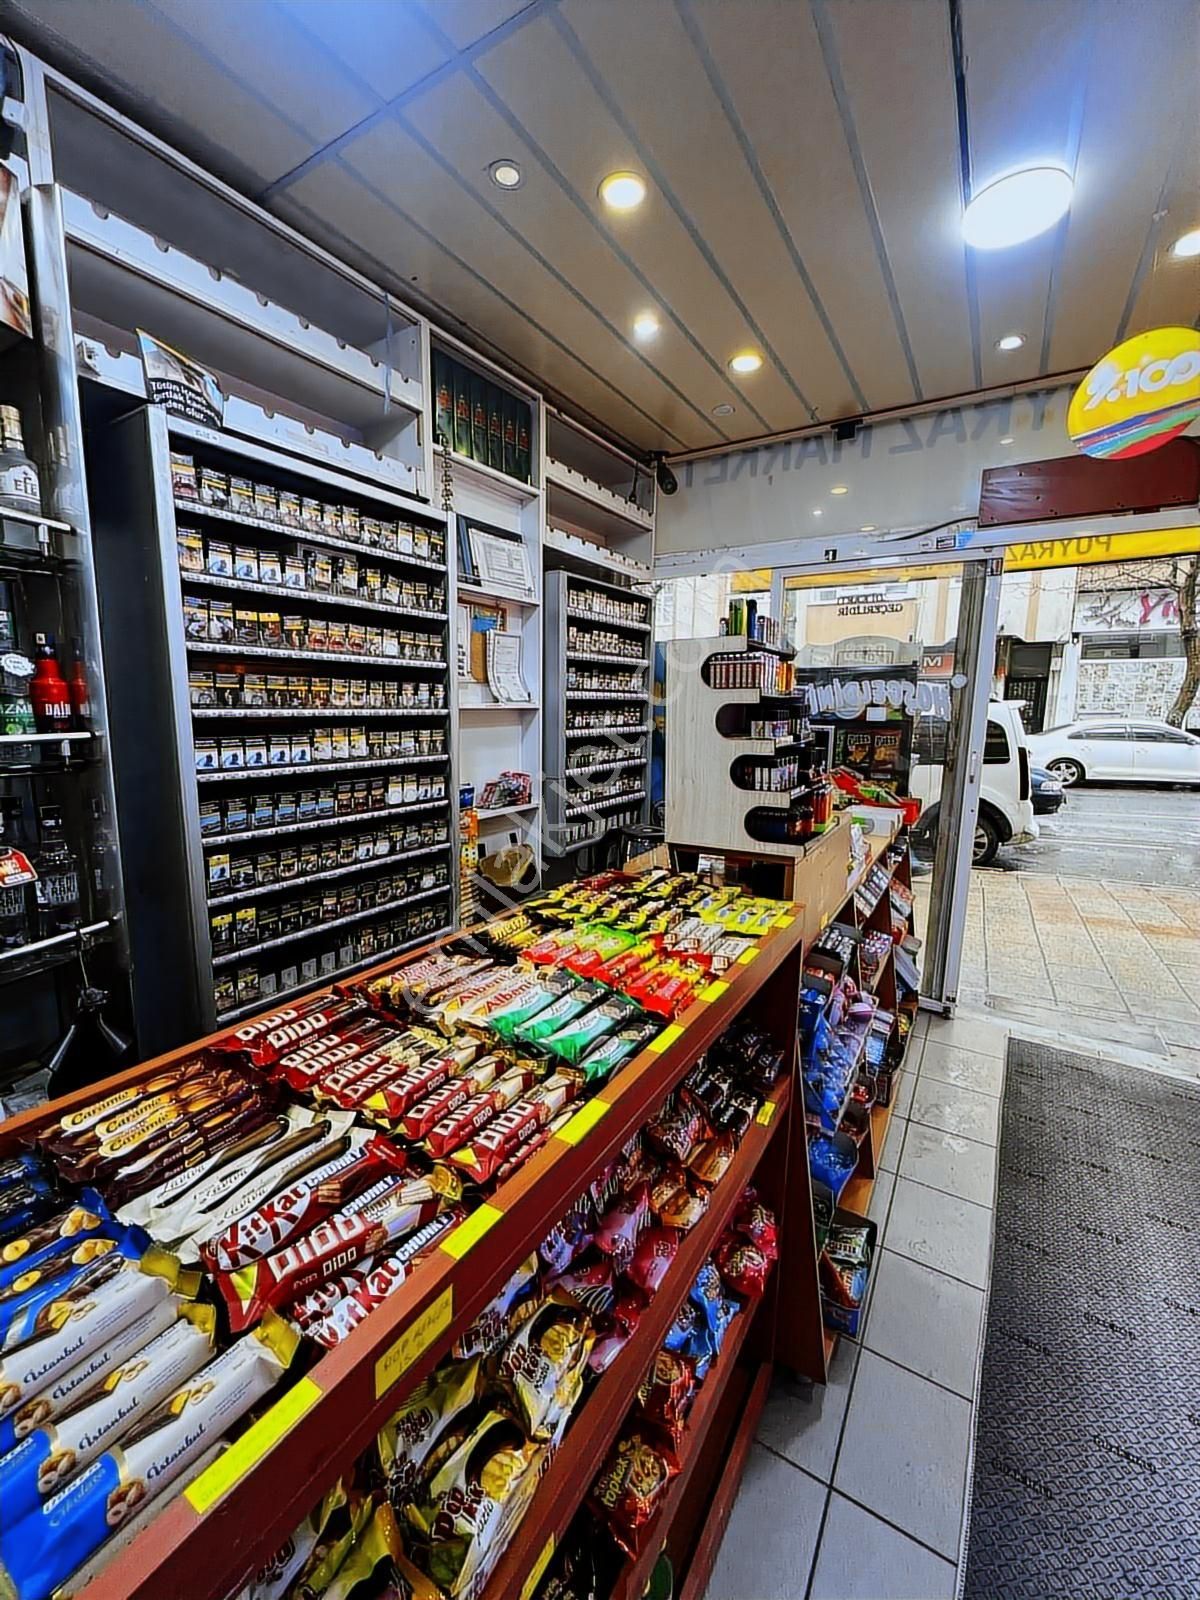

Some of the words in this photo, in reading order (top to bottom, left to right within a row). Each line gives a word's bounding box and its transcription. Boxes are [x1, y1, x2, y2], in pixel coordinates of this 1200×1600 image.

[459, 973, 508, 1006] Albeni
[486, 980, 534, 1013] Albeni
[308, 1145, 366, 1188] CHUNKY
[341, 1174, 401, 1218] CHUNKY
[23, 1336, 85, 1385] İstanbul
[52, 1352, 113, 1401] İstanbul
[78, 1397, 141, 1451] İstanbul
[146, 1423, 208, 1480] İstanbul
